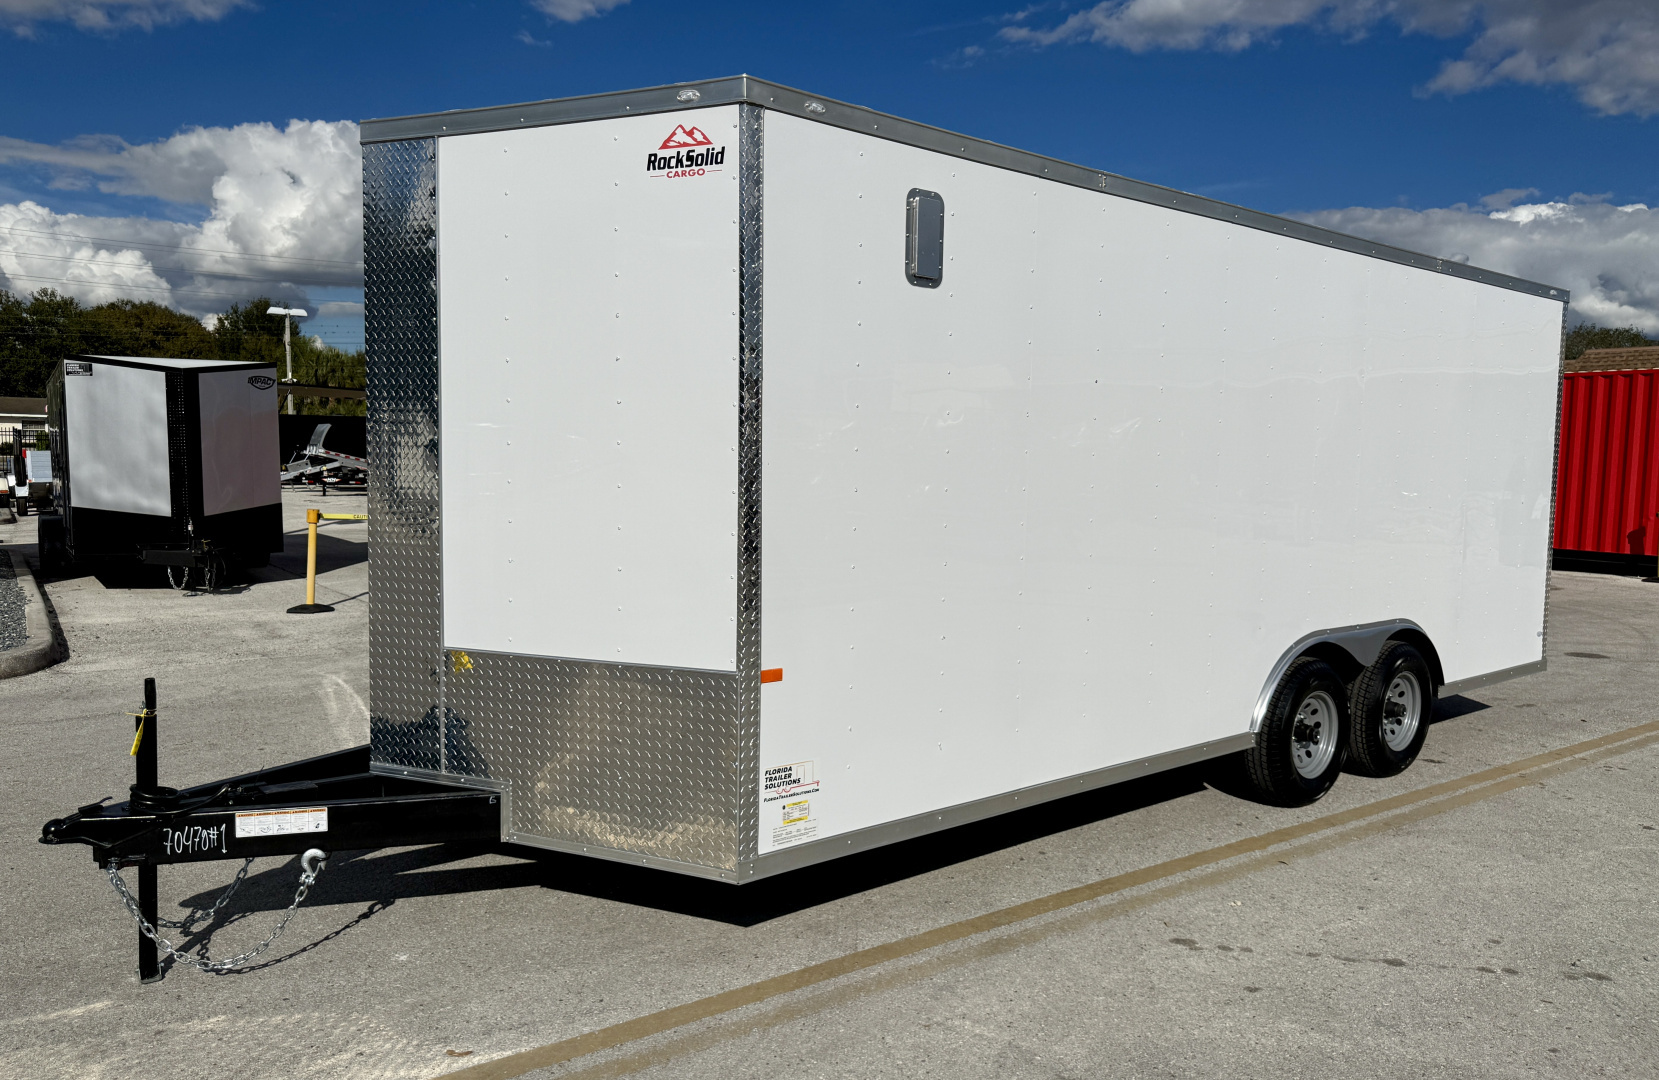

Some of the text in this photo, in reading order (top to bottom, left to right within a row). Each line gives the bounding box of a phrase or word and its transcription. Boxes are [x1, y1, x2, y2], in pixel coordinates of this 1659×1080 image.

[647, 146, 725, 171] RockSolid
[666, 168, 706, 178] CARGO
[765, 766, 793, 776] FLORIDA
[765, 773, 792, 783] TRAILER
[765, 778, 801, 790] SOLUTIONS
